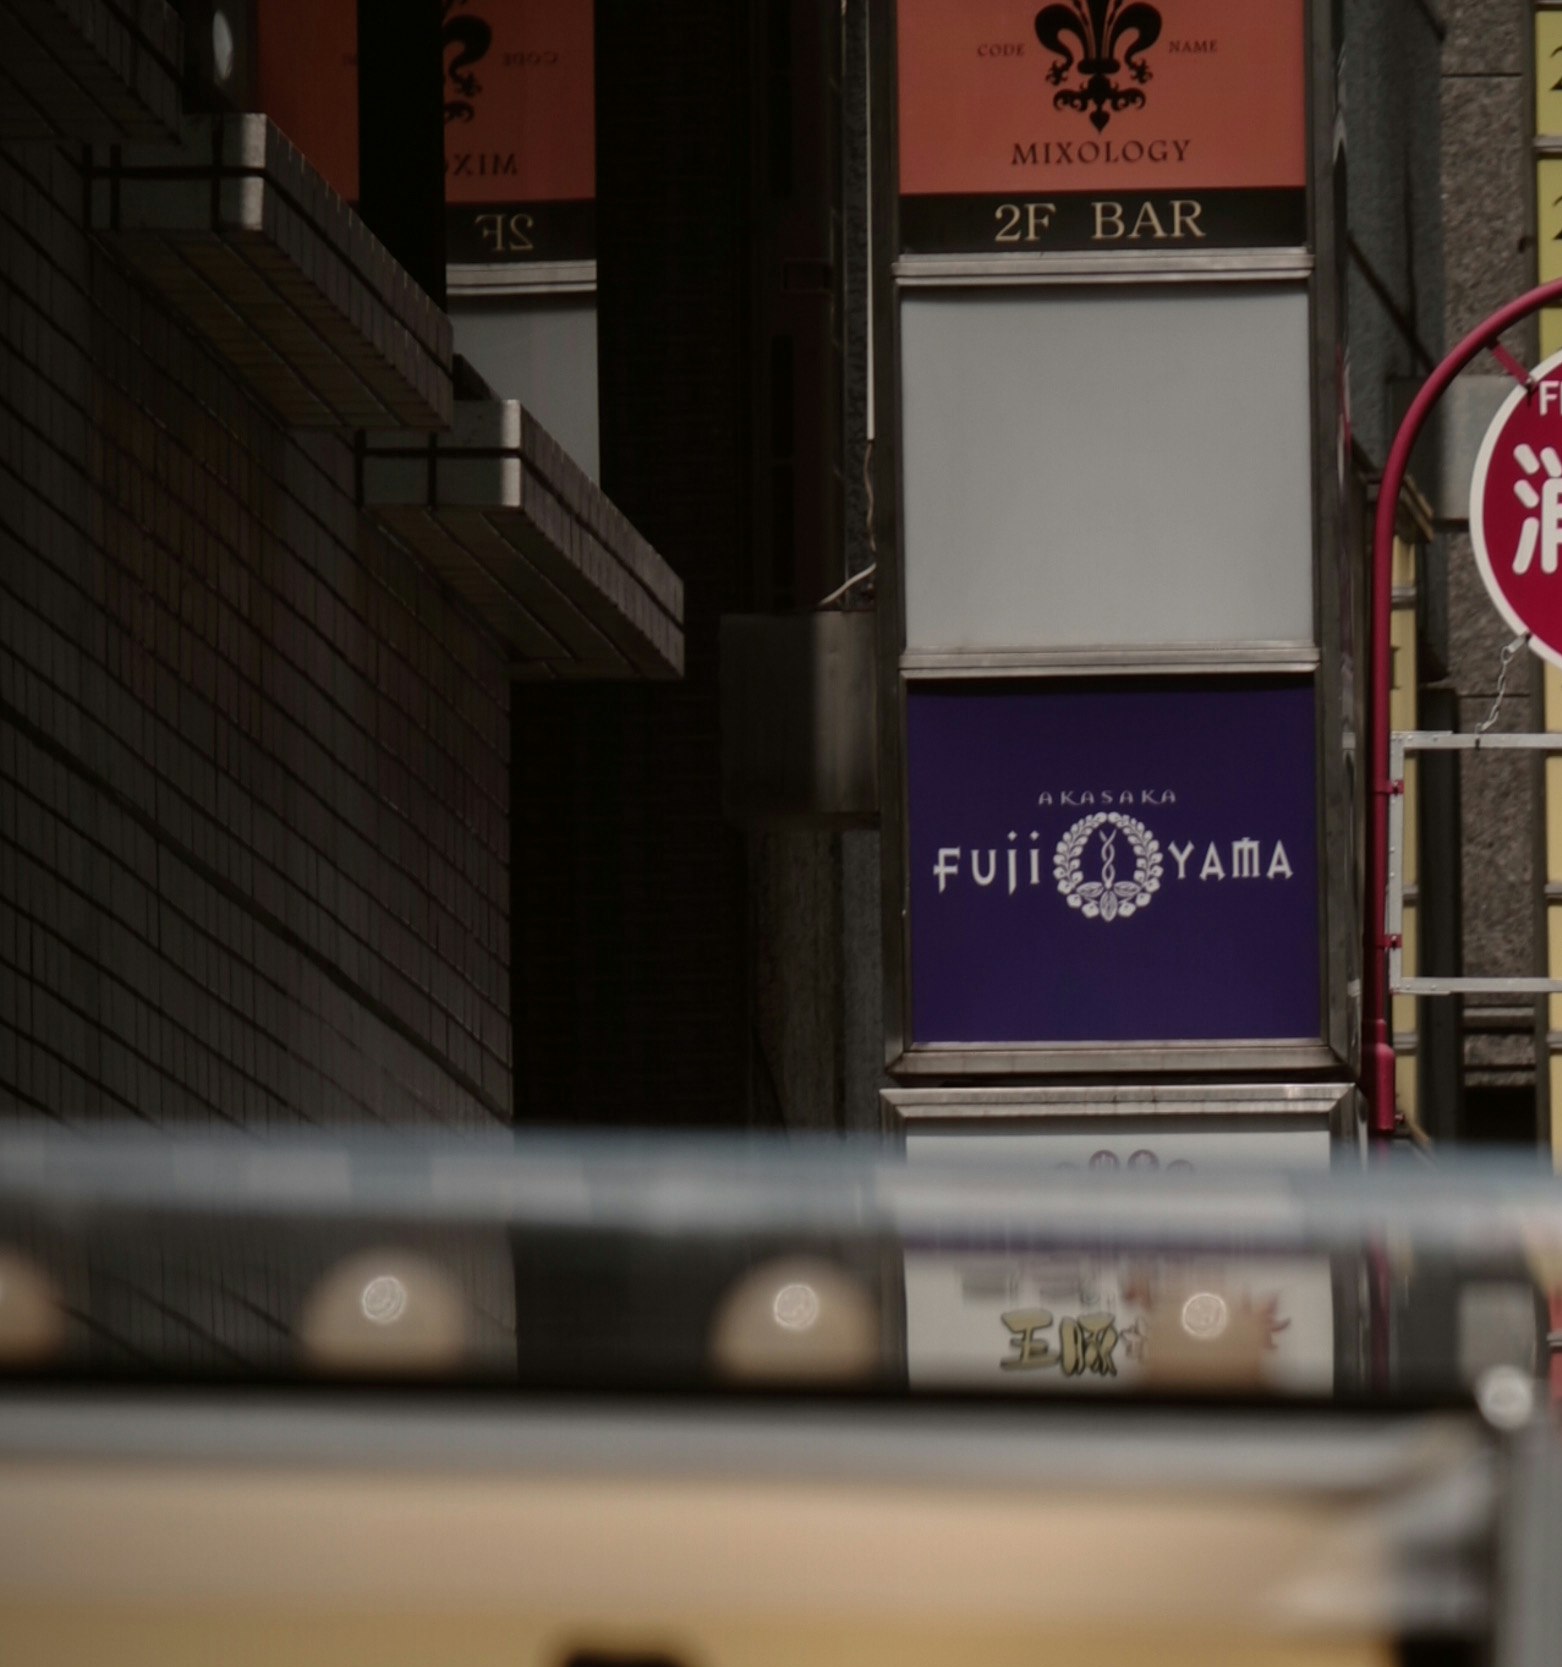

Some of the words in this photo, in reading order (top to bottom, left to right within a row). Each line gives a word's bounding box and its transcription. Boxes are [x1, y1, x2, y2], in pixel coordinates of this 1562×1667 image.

[977, 43, 1025, 57] CODE
[1168, 39, 1218, 54] NAME
[1010, 139, 1191, 166] MIXOLOGY
[995, 203, 1056, 241] 2F
[1091, 200, 1206, 240] BAR
[1038, 789, 1177, 805] AKASAKA
